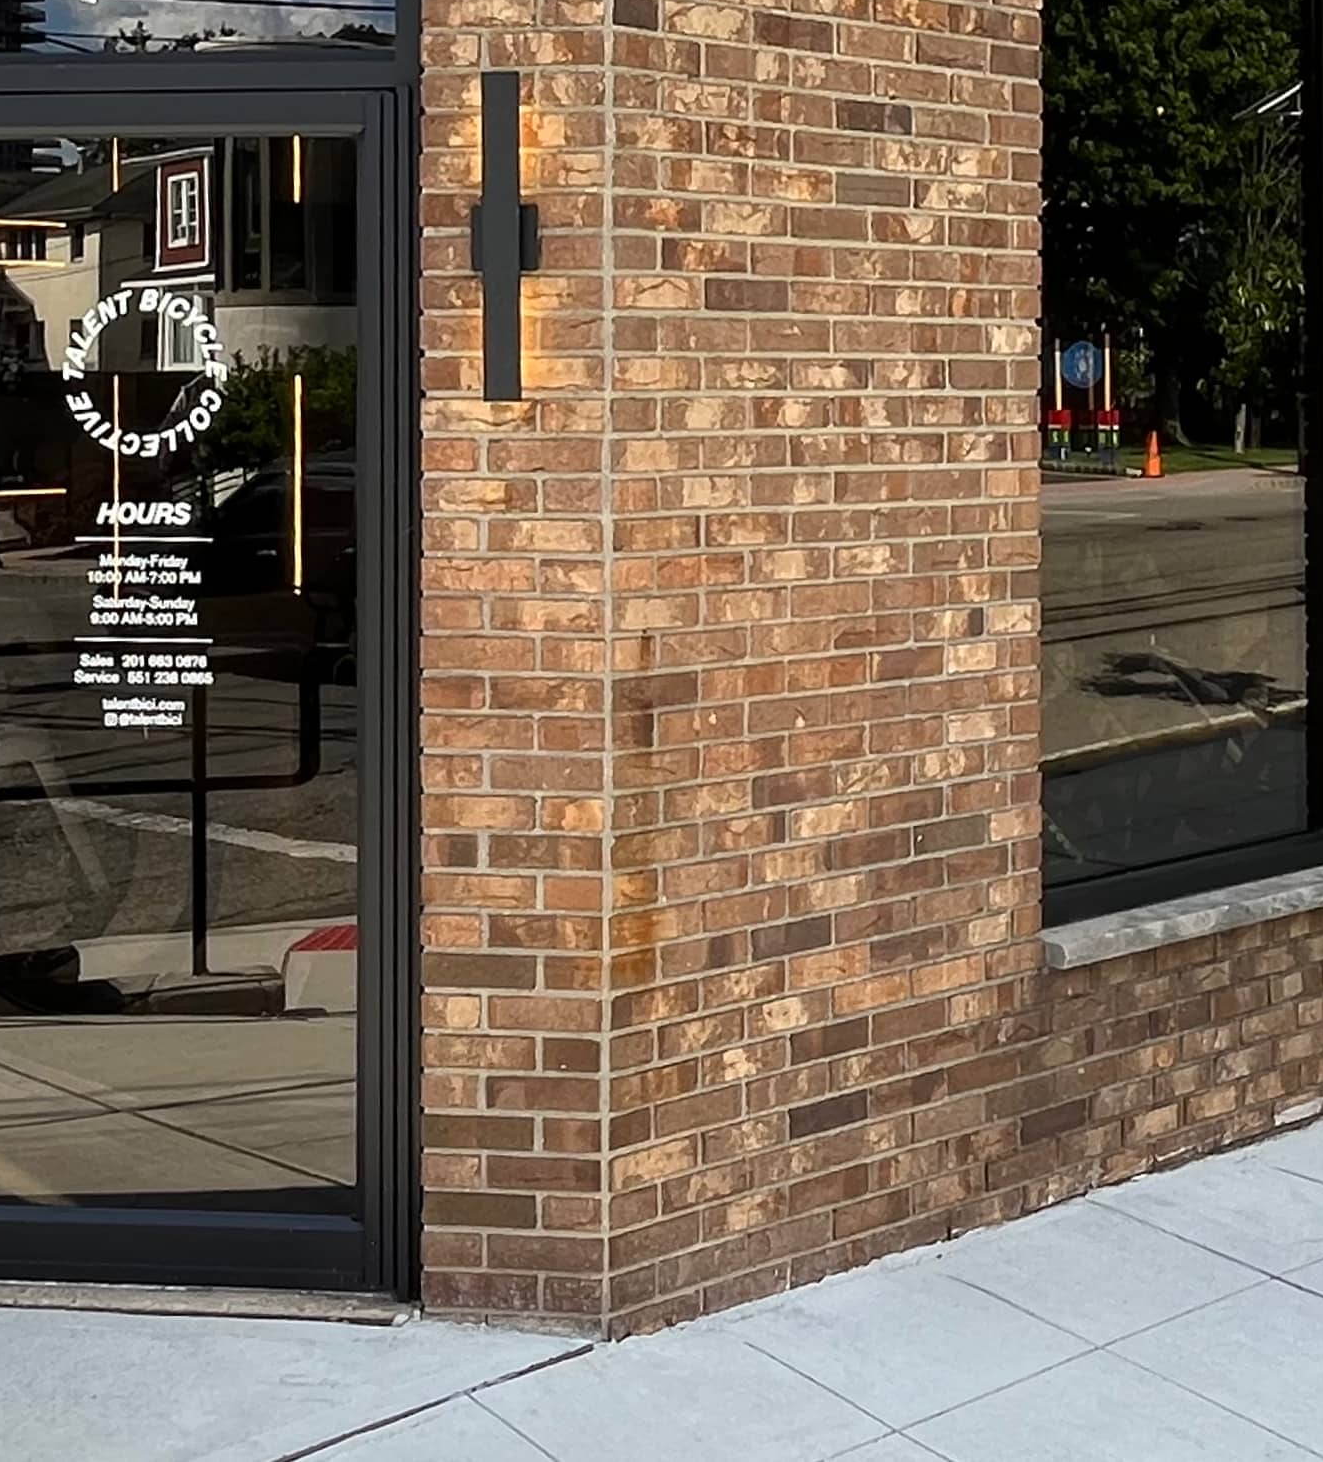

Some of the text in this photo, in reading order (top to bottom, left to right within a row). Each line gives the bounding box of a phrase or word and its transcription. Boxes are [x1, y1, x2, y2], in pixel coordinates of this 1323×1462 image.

[62, 288, 228, 458] TALENT BICYCLE COLLECTIVE
[96, 502, 192, 525] HOURS
[179, 571, 202, 584] PM
[175, 613, 198, 625] PM
[79, 653, 114, 667] Sales
[121, 654, 144, 667] 201
[74, 670, 119, 684] Service
